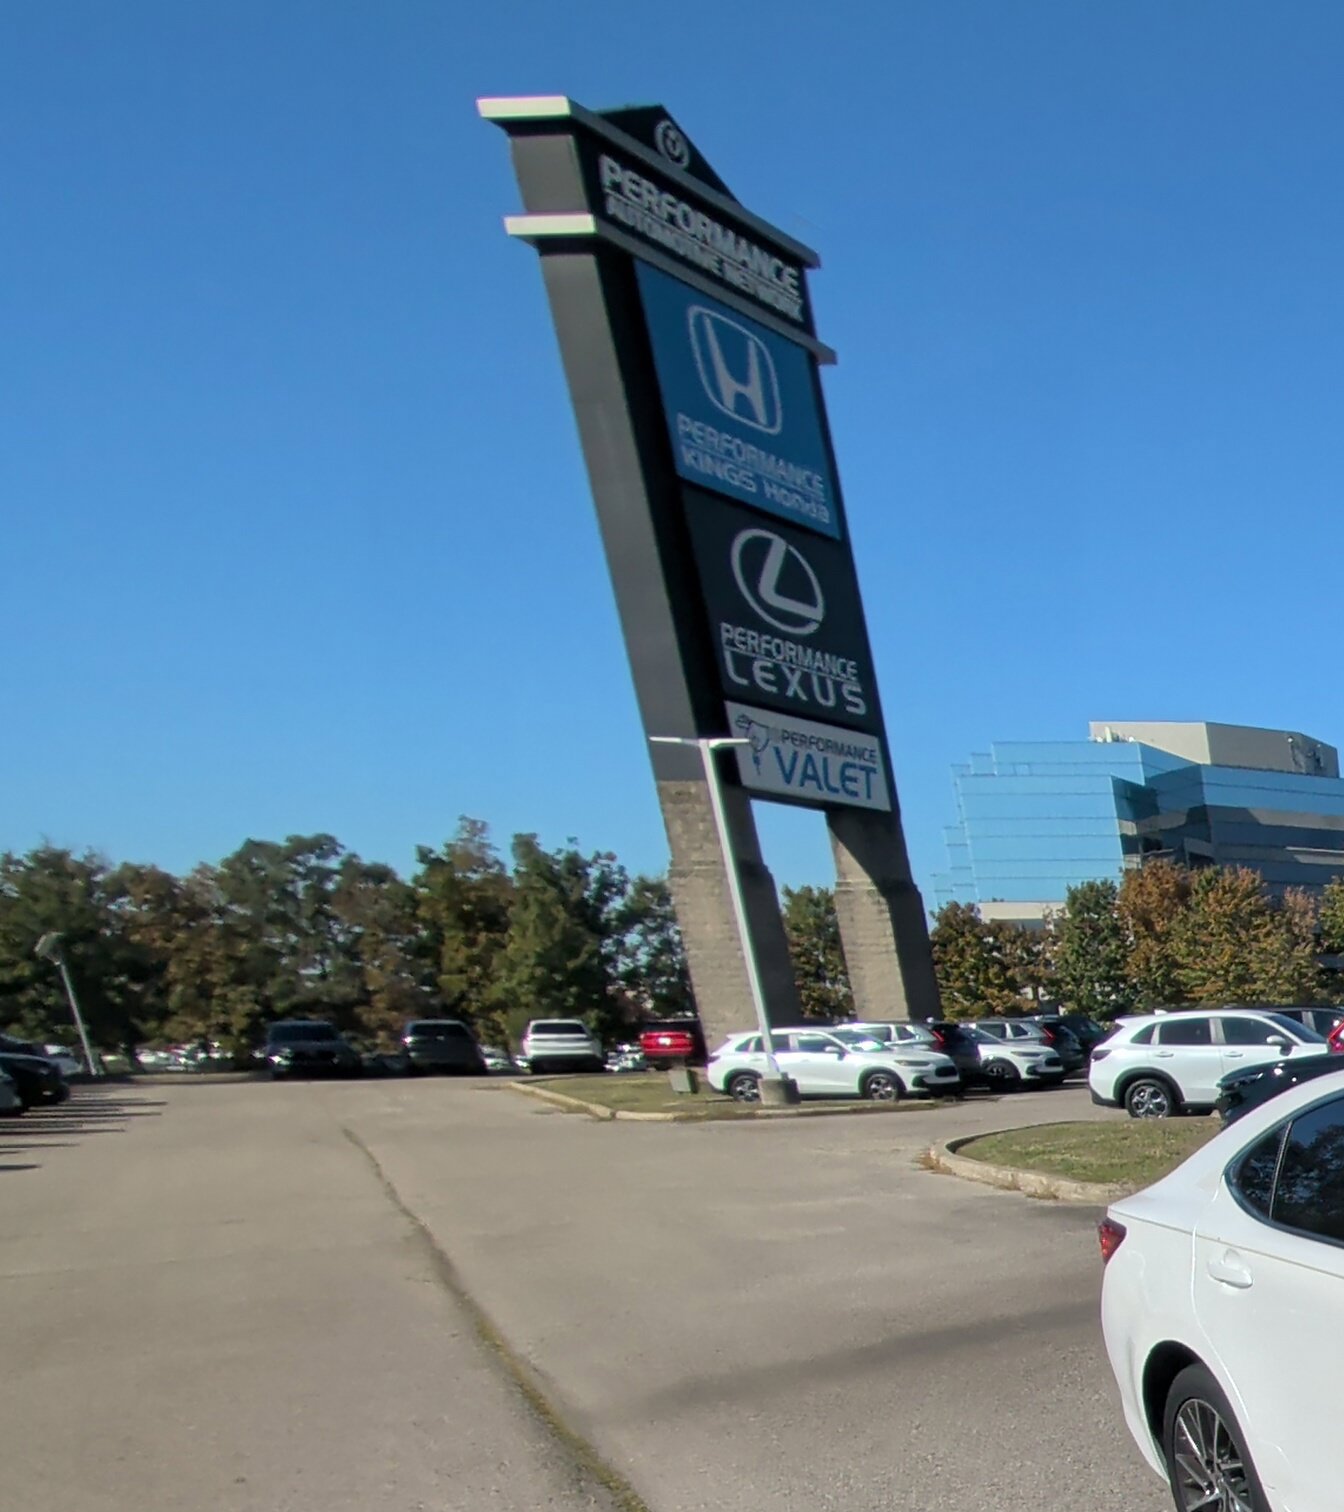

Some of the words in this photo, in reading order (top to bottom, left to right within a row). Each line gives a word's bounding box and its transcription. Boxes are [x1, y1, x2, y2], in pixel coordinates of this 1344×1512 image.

[600, 154, 799, 293] PERFORMANCE
[677, 413, 823, 488] PERFORMANCE
[681, 446, 757, 492] KINGS
[721, 623, 858, 681] PERFORMANCE
[723, 649, 866, 715] LEXUS
[773, 746, 877, 799] VALET
[781, 729, 877, 764] PERFORMANCE
